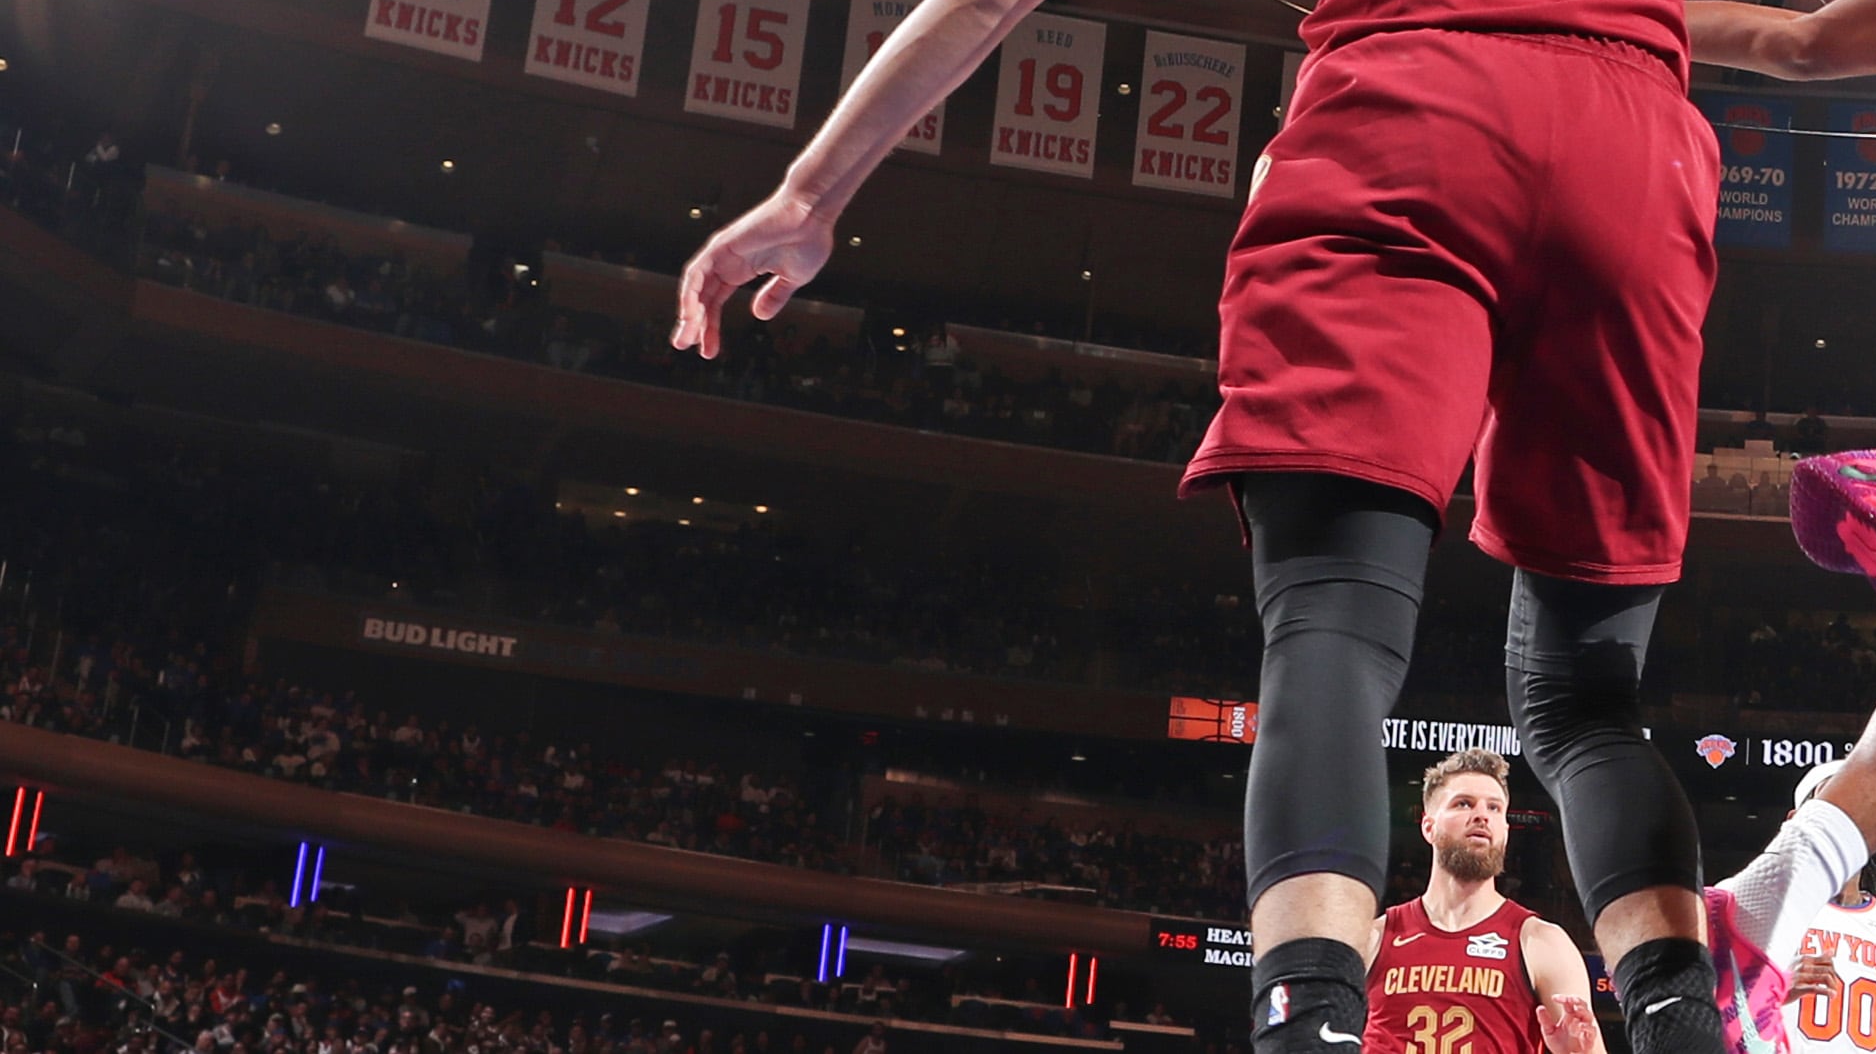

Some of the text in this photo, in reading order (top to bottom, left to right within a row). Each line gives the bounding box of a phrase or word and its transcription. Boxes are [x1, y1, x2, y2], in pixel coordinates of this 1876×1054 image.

[712, 2, 789, 71] 15
[1035, 28, 1073, 49] REED
[533, 34, 635, 82] KNICKS
[693, 72, 792, 116] KNICKS
[1014, 57, 1084, 123] 19
[1146, 79, 1232, 146] 22
[997, 126, 1091, 165] KNICKS
[1139, 148, 1231, 185] KNICKS
[1720, 165, 1785, 187] 969-70
[1719, 190, 1769, 206] WORLD
[363, 617, 518, 657] BUD LIGHT
[1231, 706, 1246, 738] 1800
[1381, 718, 1521, 756] STE IS EVERYTHING
[1761, 739, 1833, 768] 1800
[1158, 932, 1199, 950] 7:55
[1799, 928, 1842, 958] EW
[1384, 965, 1505, 998] CLEVELAND
[1405, 1005, 1475, 1054] 32
